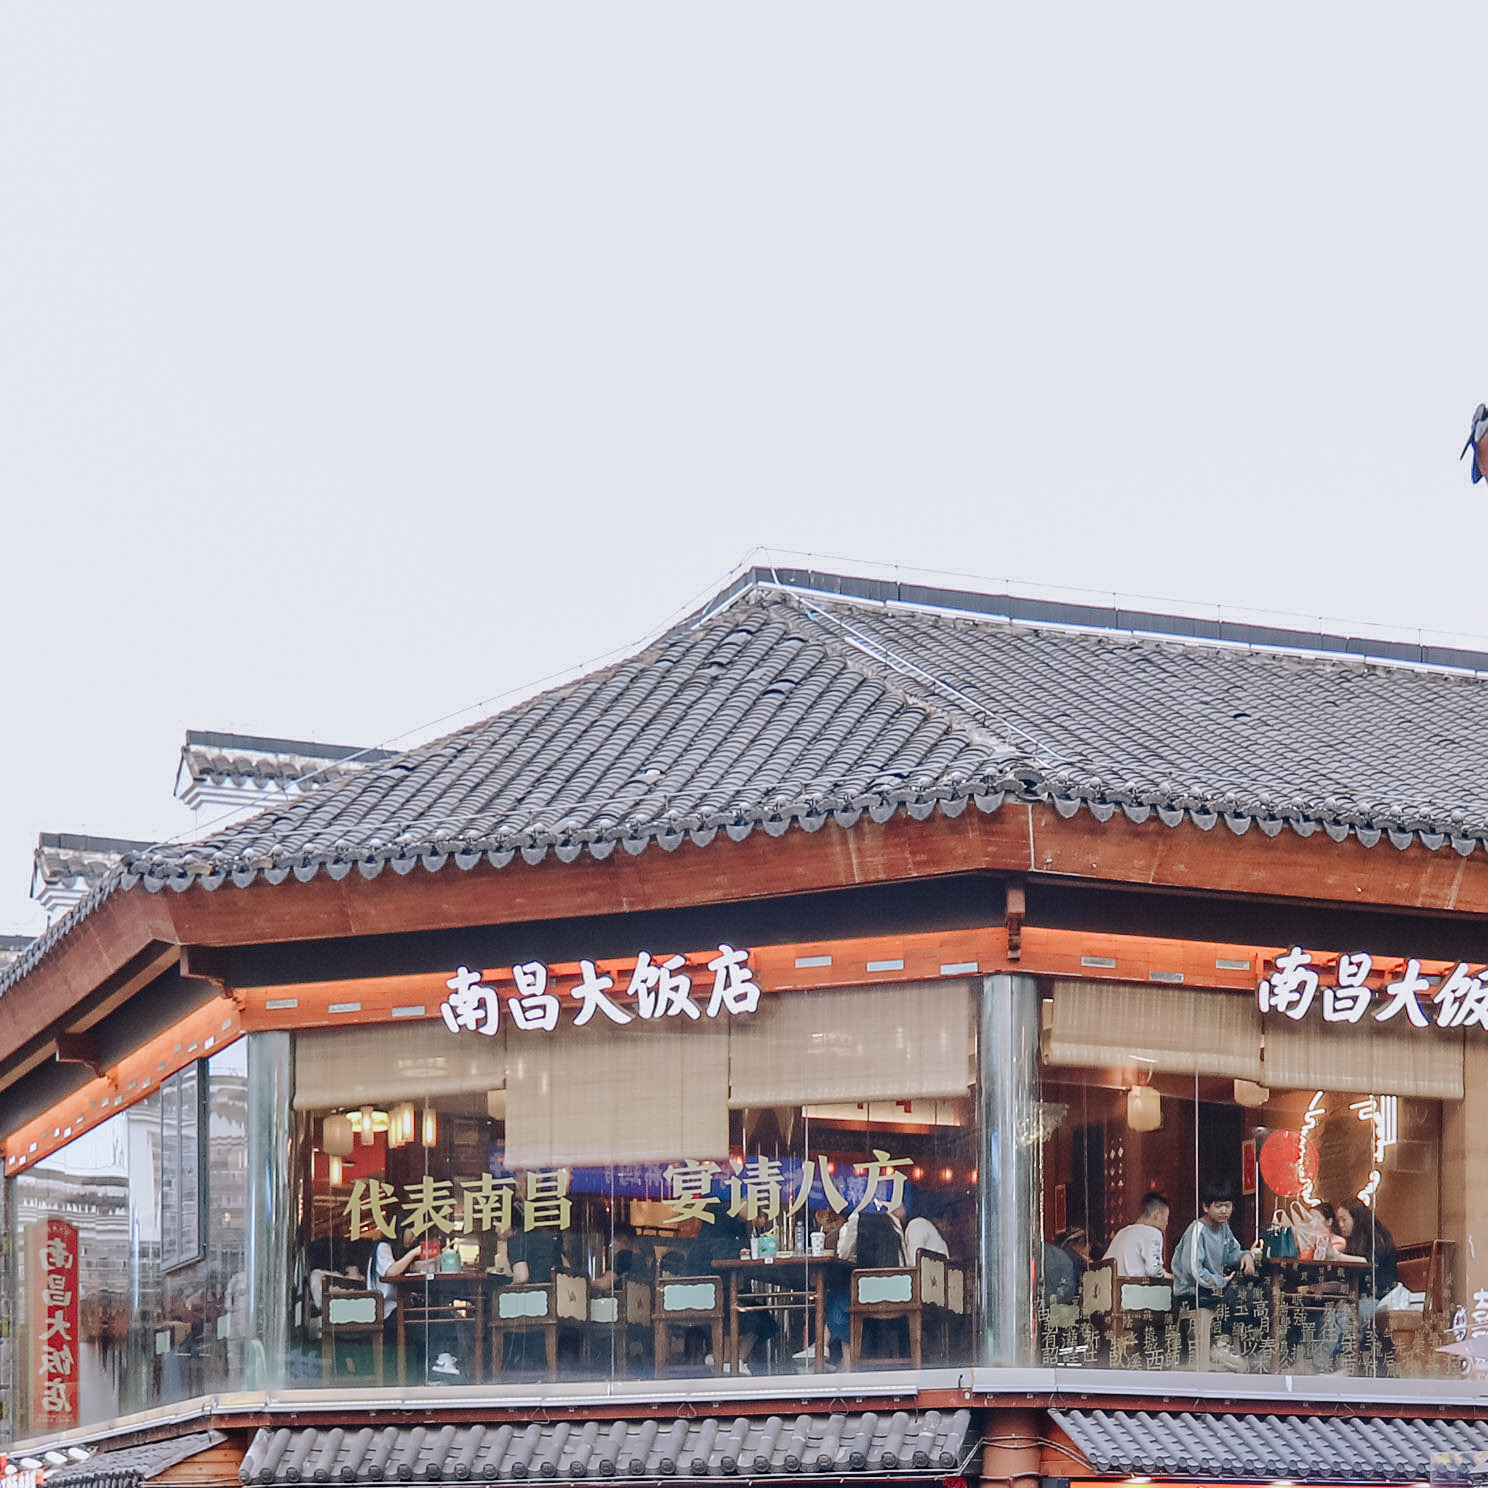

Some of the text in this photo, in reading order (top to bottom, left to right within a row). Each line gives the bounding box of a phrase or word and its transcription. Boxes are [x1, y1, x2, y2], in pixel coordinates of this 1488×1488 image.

[440, 943, 763, 1037] 南昌大饭店
[343, 1168, 573, 1242] 代表南昌
[663, 1149, 914, 1226] 宴请八方
